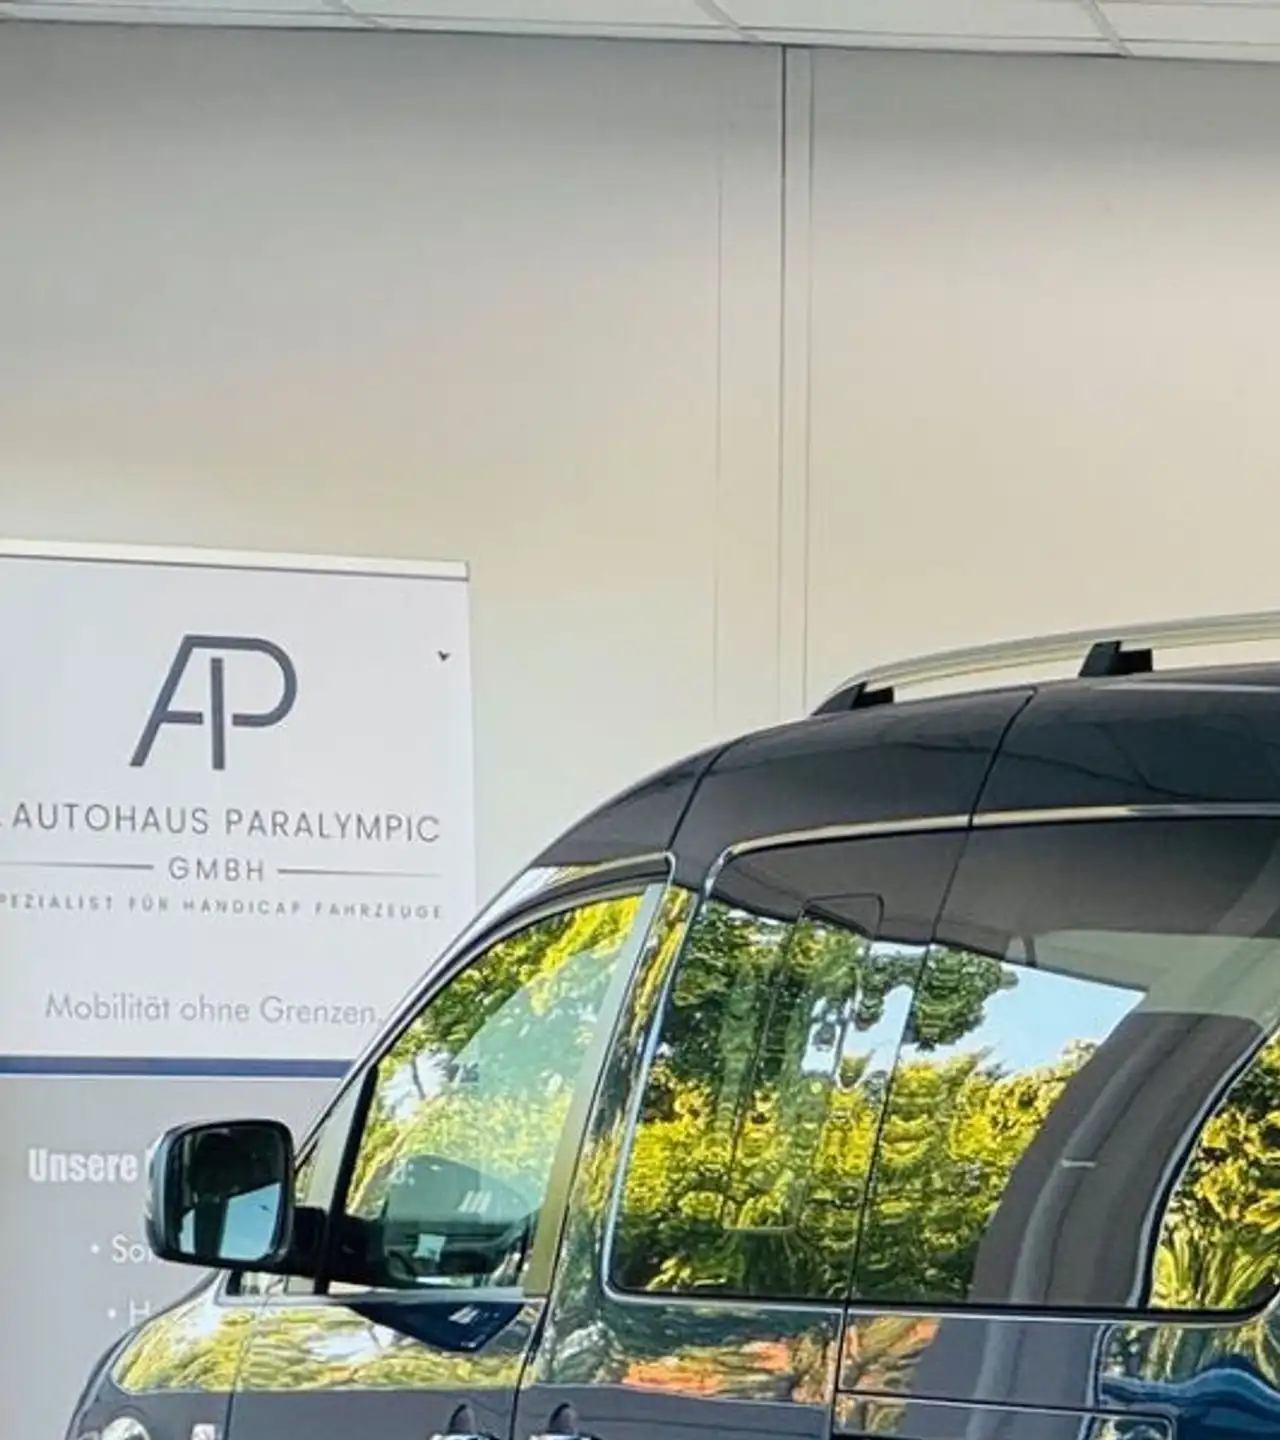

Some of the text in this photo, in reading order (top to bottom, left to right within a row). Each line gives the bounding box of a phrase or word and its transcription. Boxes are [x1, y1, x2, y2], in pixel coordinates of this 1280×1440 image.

[11, 801, 441, 843] AUTOHAUS PARALYMPIC
[167, 856, 265, 883] GMBH
[44, 993, 171, 1023] Mobilität
[179, 994, 251, 1022] ohne
[28, 1148, 139, 1182] Unsere
